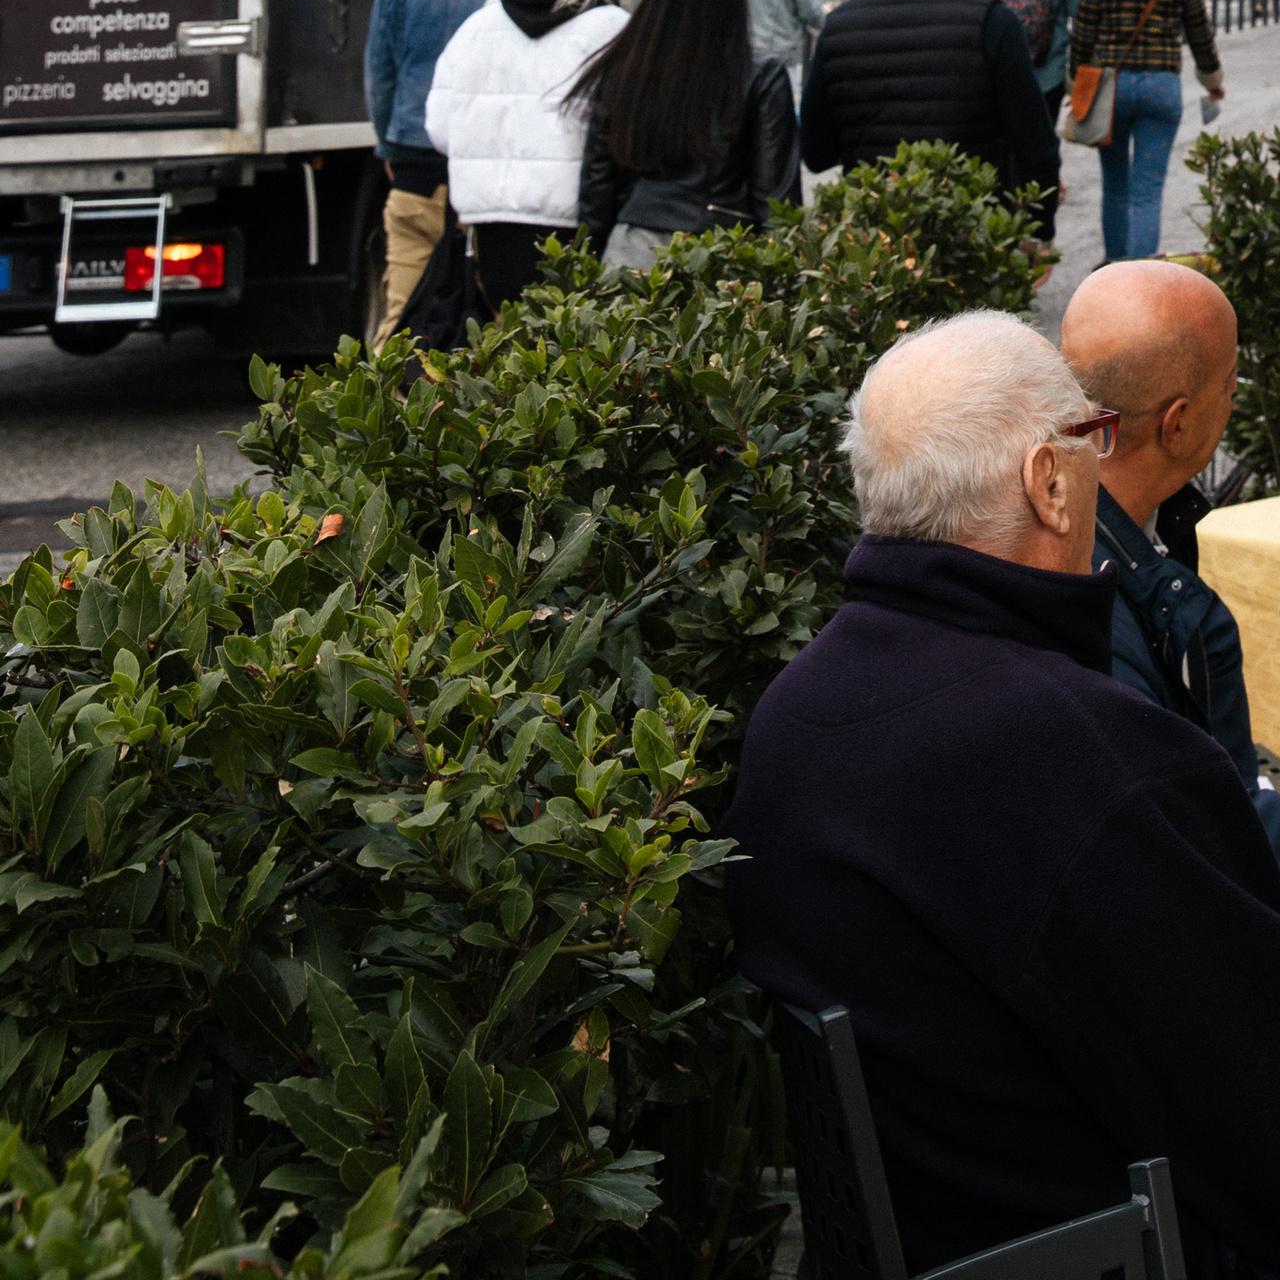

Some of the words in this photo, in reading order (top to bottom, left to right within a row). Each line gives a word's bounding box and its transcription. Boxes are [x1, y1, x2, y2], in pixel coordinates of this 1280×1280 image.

[51, 9, 170, 39] competenza
[45, 44, 100, 69] prodotti
[3, 76, 75, 107] pizzeria
[103, 72, 209, 105] selvaggina
[55, 260, 126, 277] AILY
